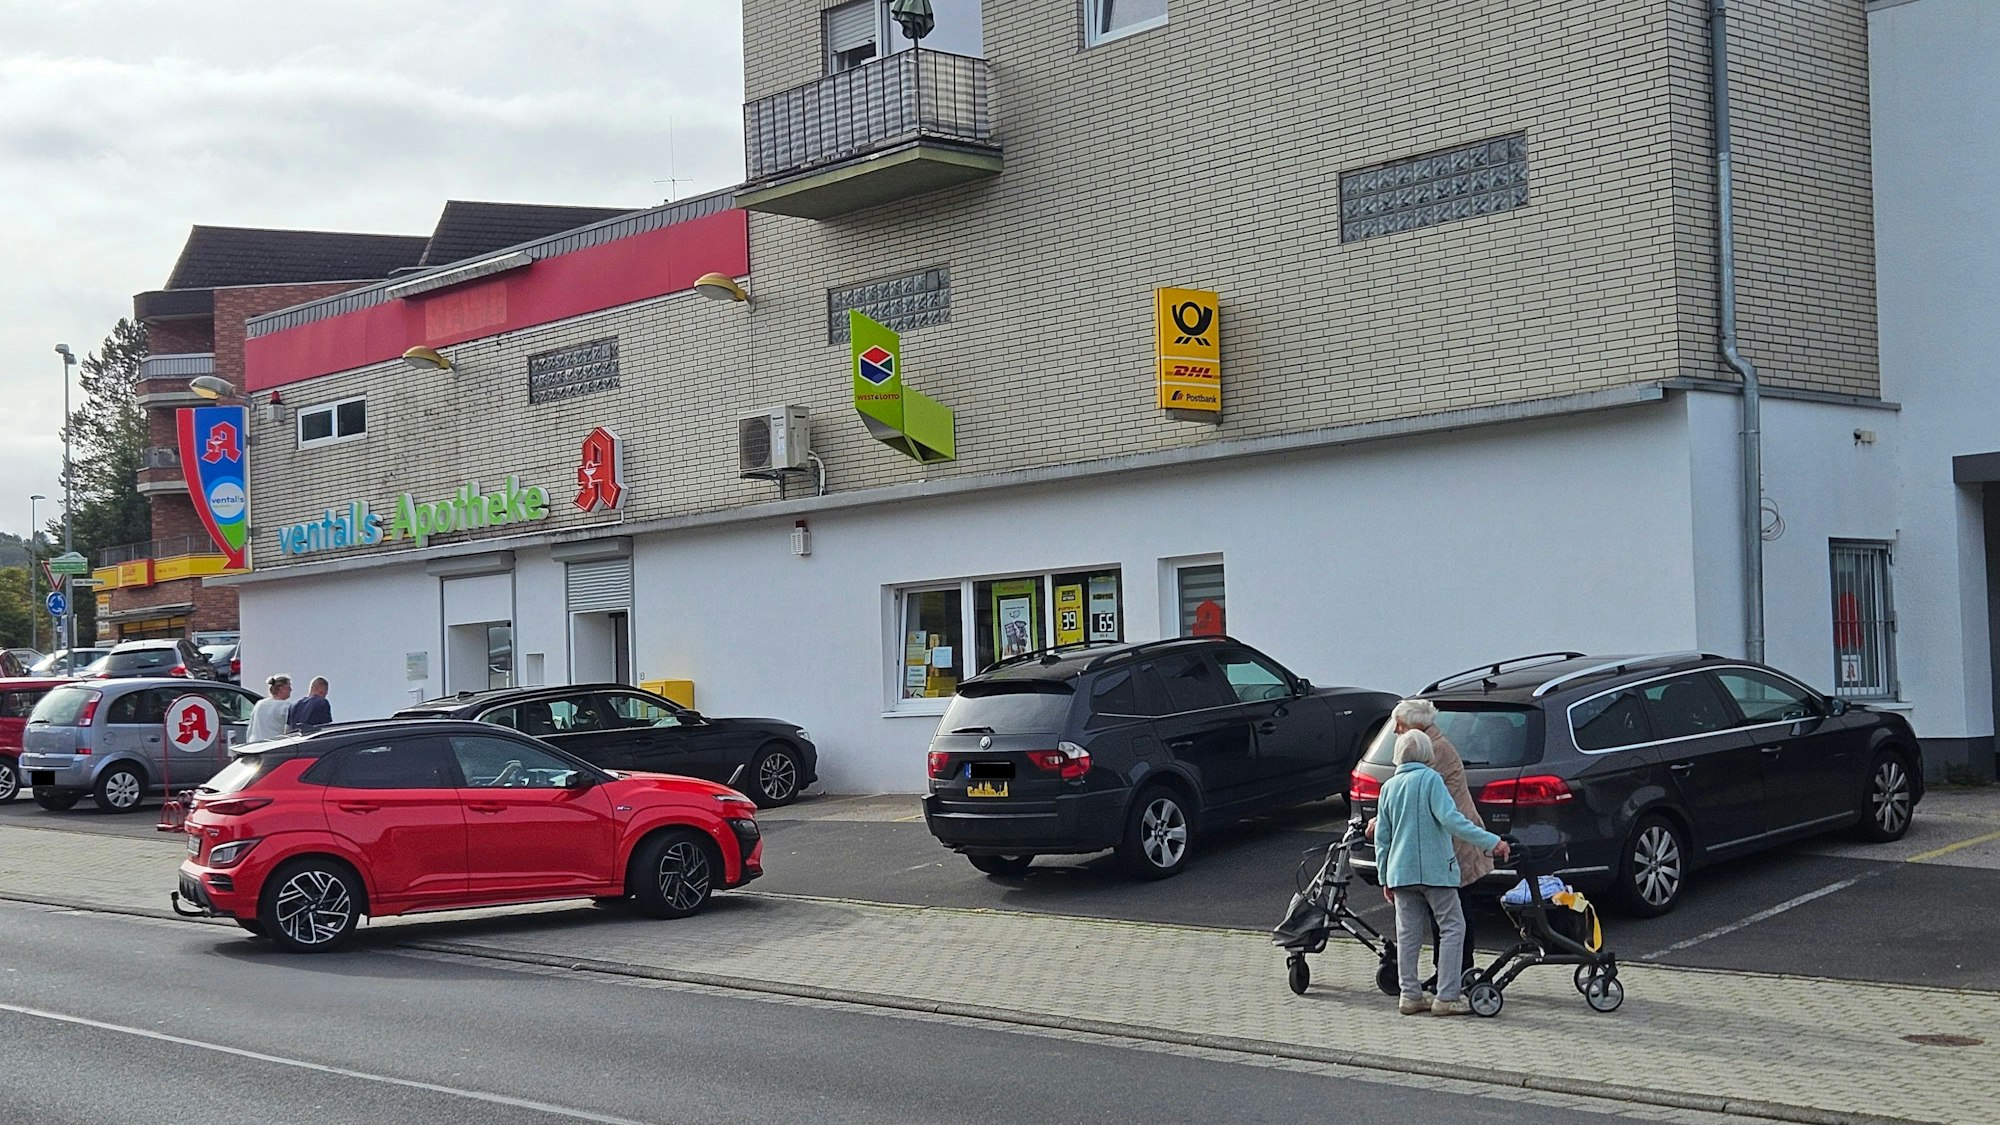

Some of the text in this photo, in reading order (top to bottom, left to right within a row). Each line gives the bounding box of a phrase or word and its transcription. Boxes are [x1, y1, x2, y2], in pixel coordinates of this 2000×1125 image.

[1173, 365, 1213, 379] DHL
[1186, 393, 1217, 404] Postbank
[391, 475, 549, 547] Apotheke
[1062, 612, 1077, 630] 39
[1099, 613, 1114, 632] 65
